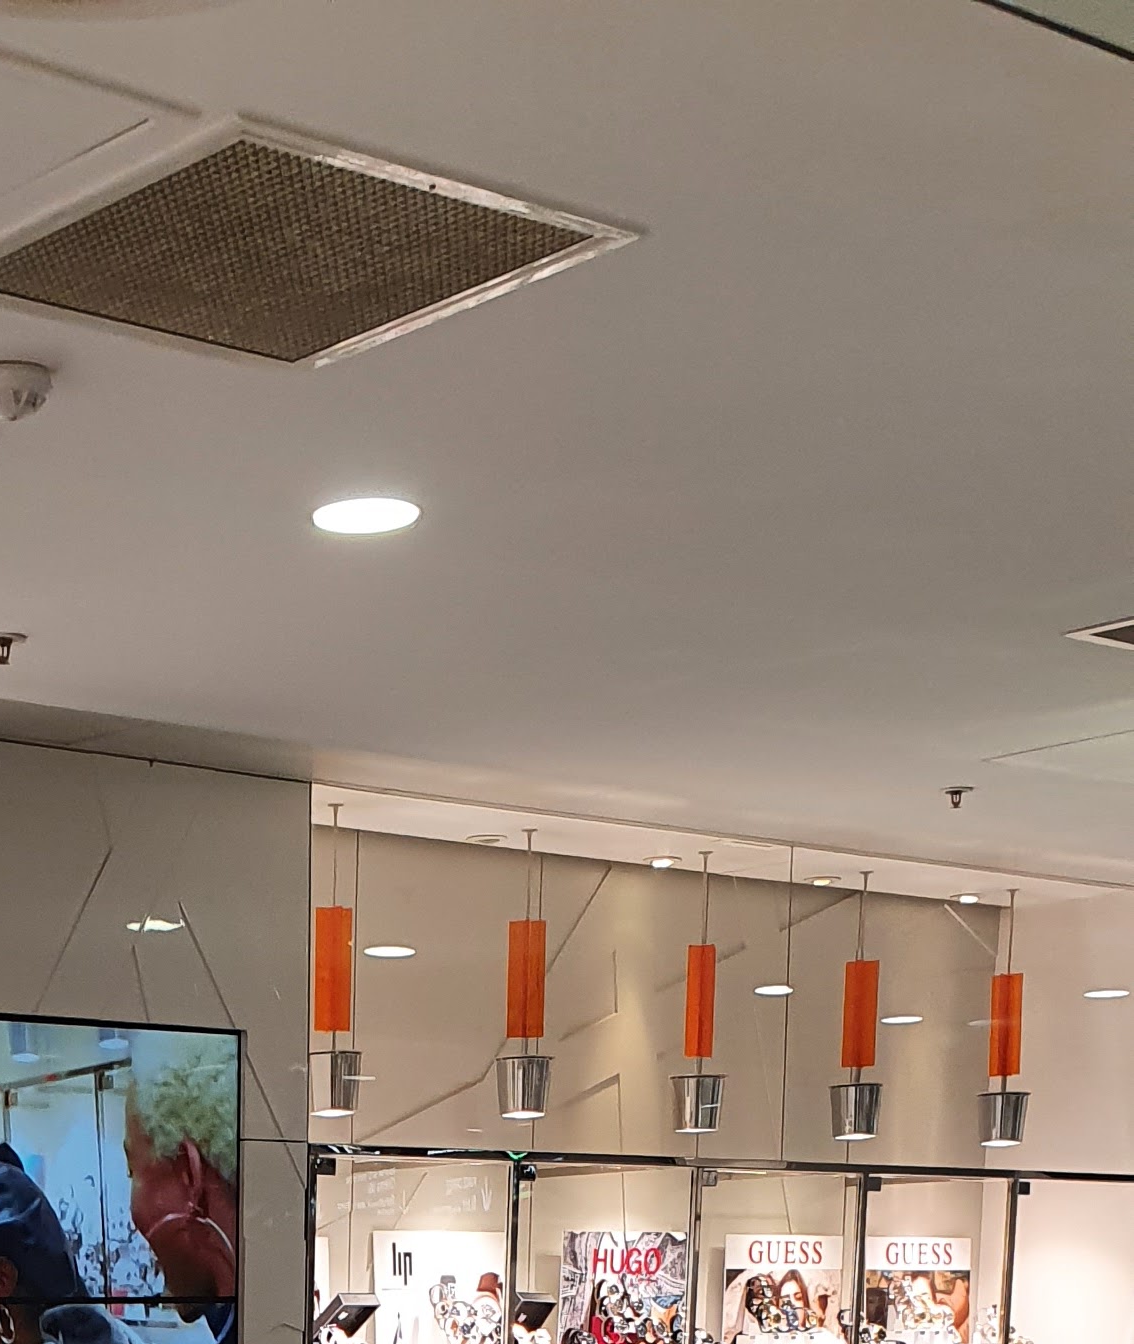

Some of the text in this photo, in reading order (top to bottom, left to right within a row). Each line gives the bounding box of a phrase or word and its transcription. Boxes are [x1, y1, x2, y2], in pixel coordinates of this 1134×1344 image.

[592, 1247, 662, 1275] HUGO
[748, 1240, 823, 1264] GUESS
[885, 1242, 953, 1265] GUESS
